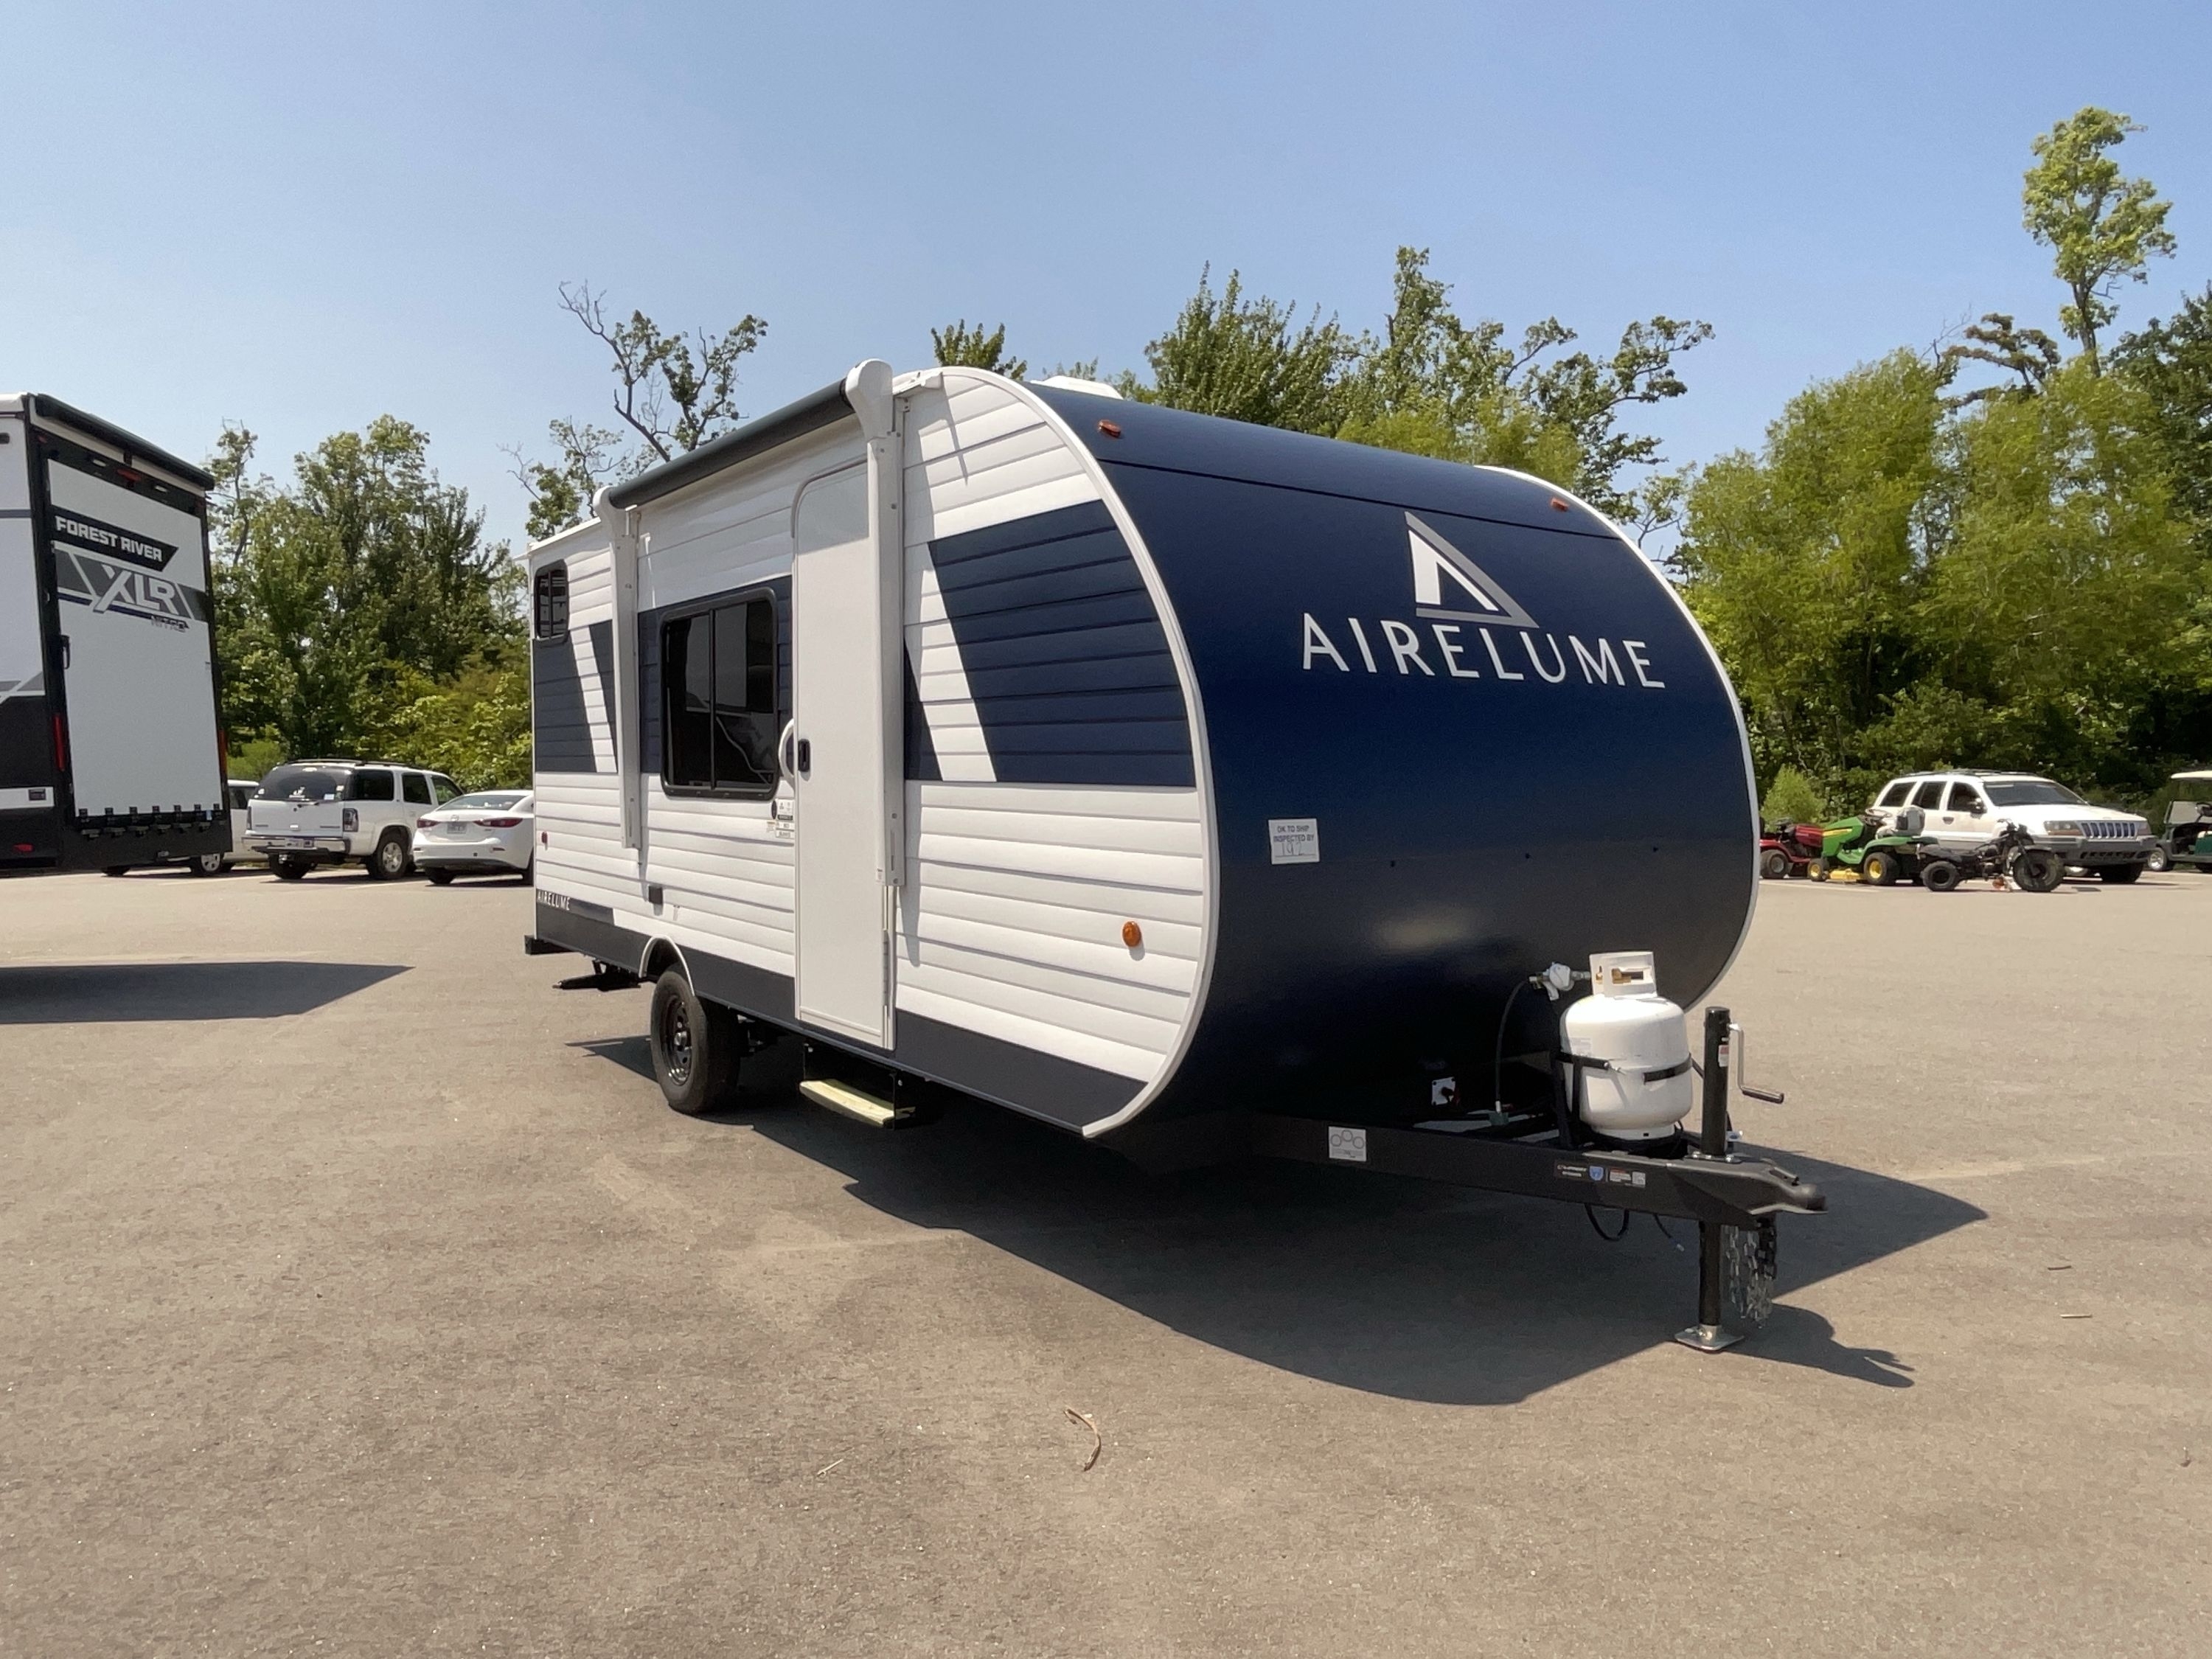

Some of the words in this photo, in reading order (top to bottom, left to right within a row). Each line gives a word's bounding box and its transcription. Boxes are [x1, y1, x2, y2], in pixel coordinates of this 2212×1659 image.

[55, 515, 119, 548] FOREST
[120, 536, 162, 562] RIVER
[94, 563, 180, 613] XLR
[1302, 612, 1666, 689] AIRELUME
[538, 890, 571, 911] AIRELUME
